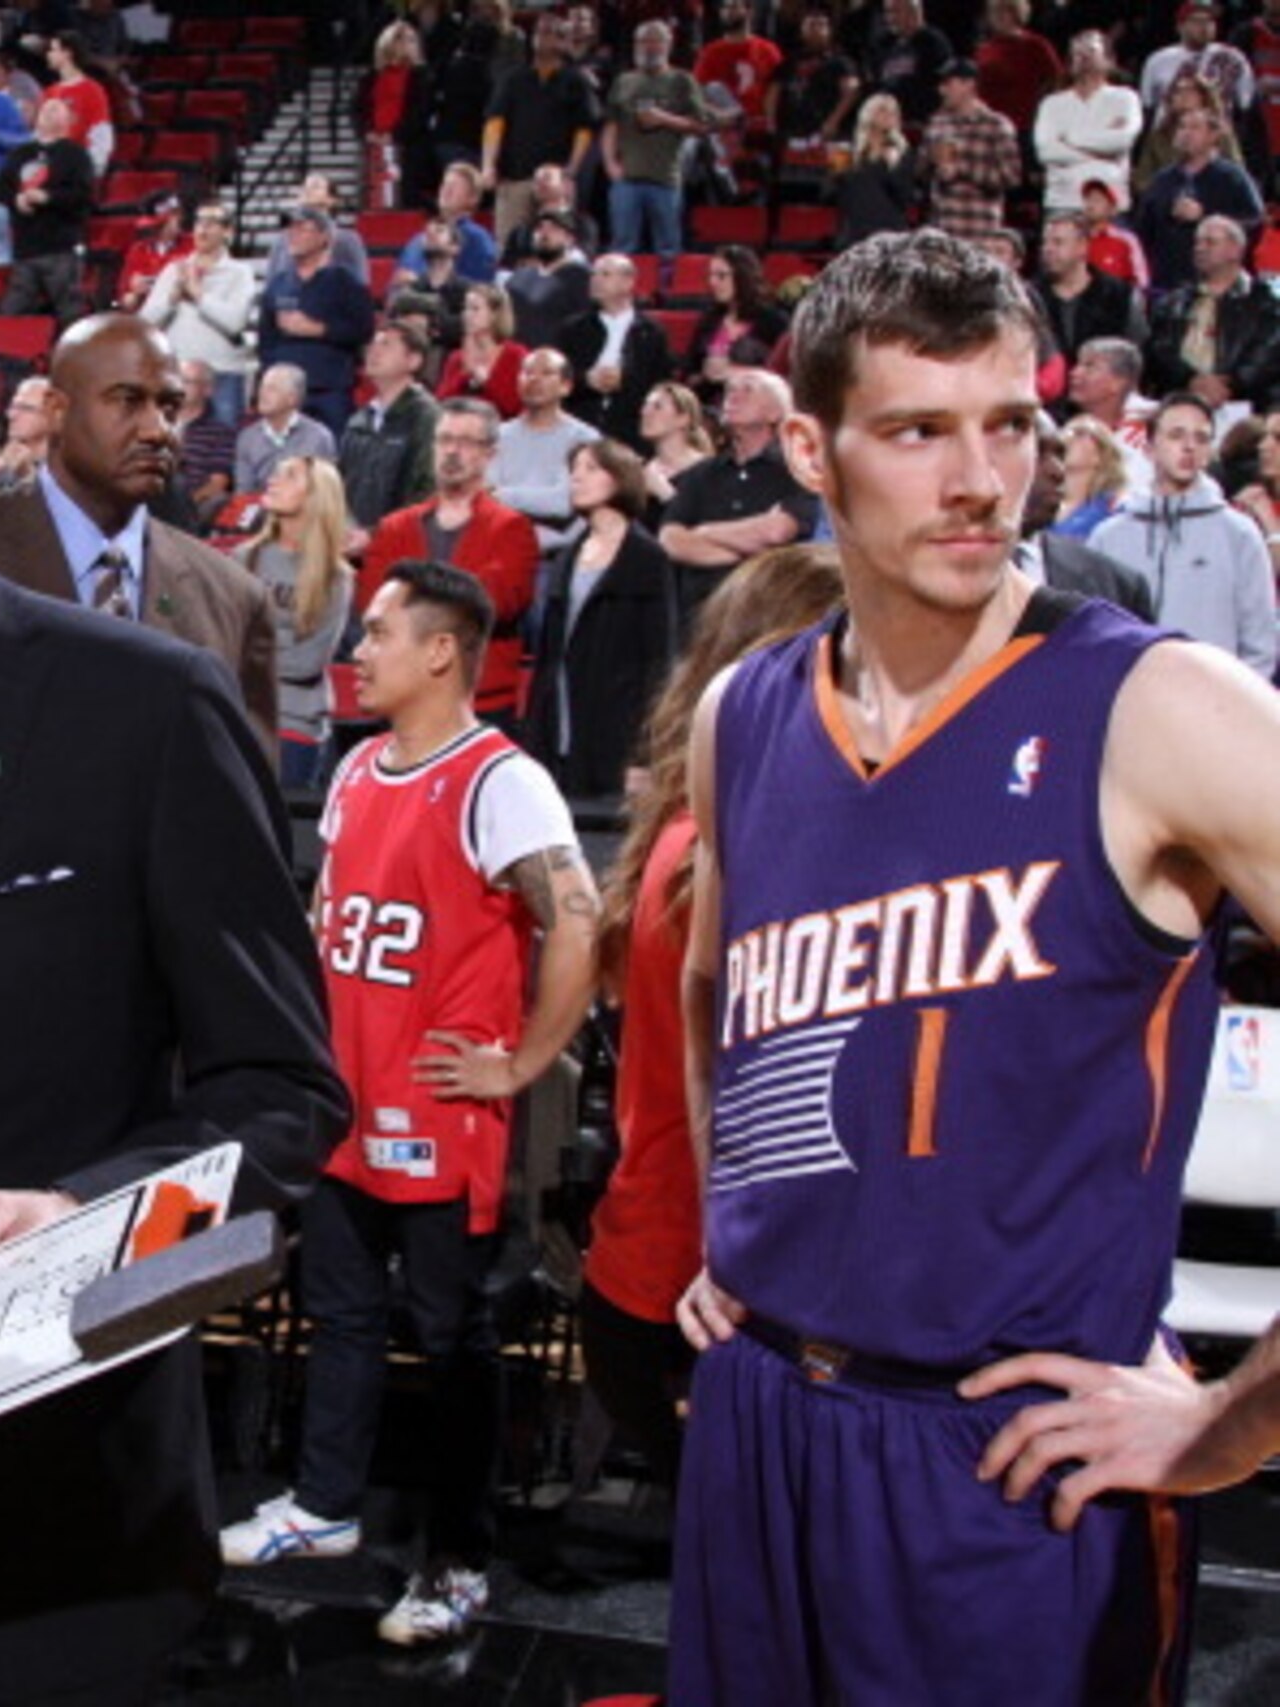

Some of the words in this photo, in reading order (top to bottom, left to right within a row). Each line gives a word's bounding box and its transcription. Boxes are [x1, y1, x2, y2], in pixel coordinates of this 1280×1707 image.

[331, 894, 423, 987] 32
[722, 860, 1062, 1050] PHOENIX
[907, 1007, 949, 1157] 1
